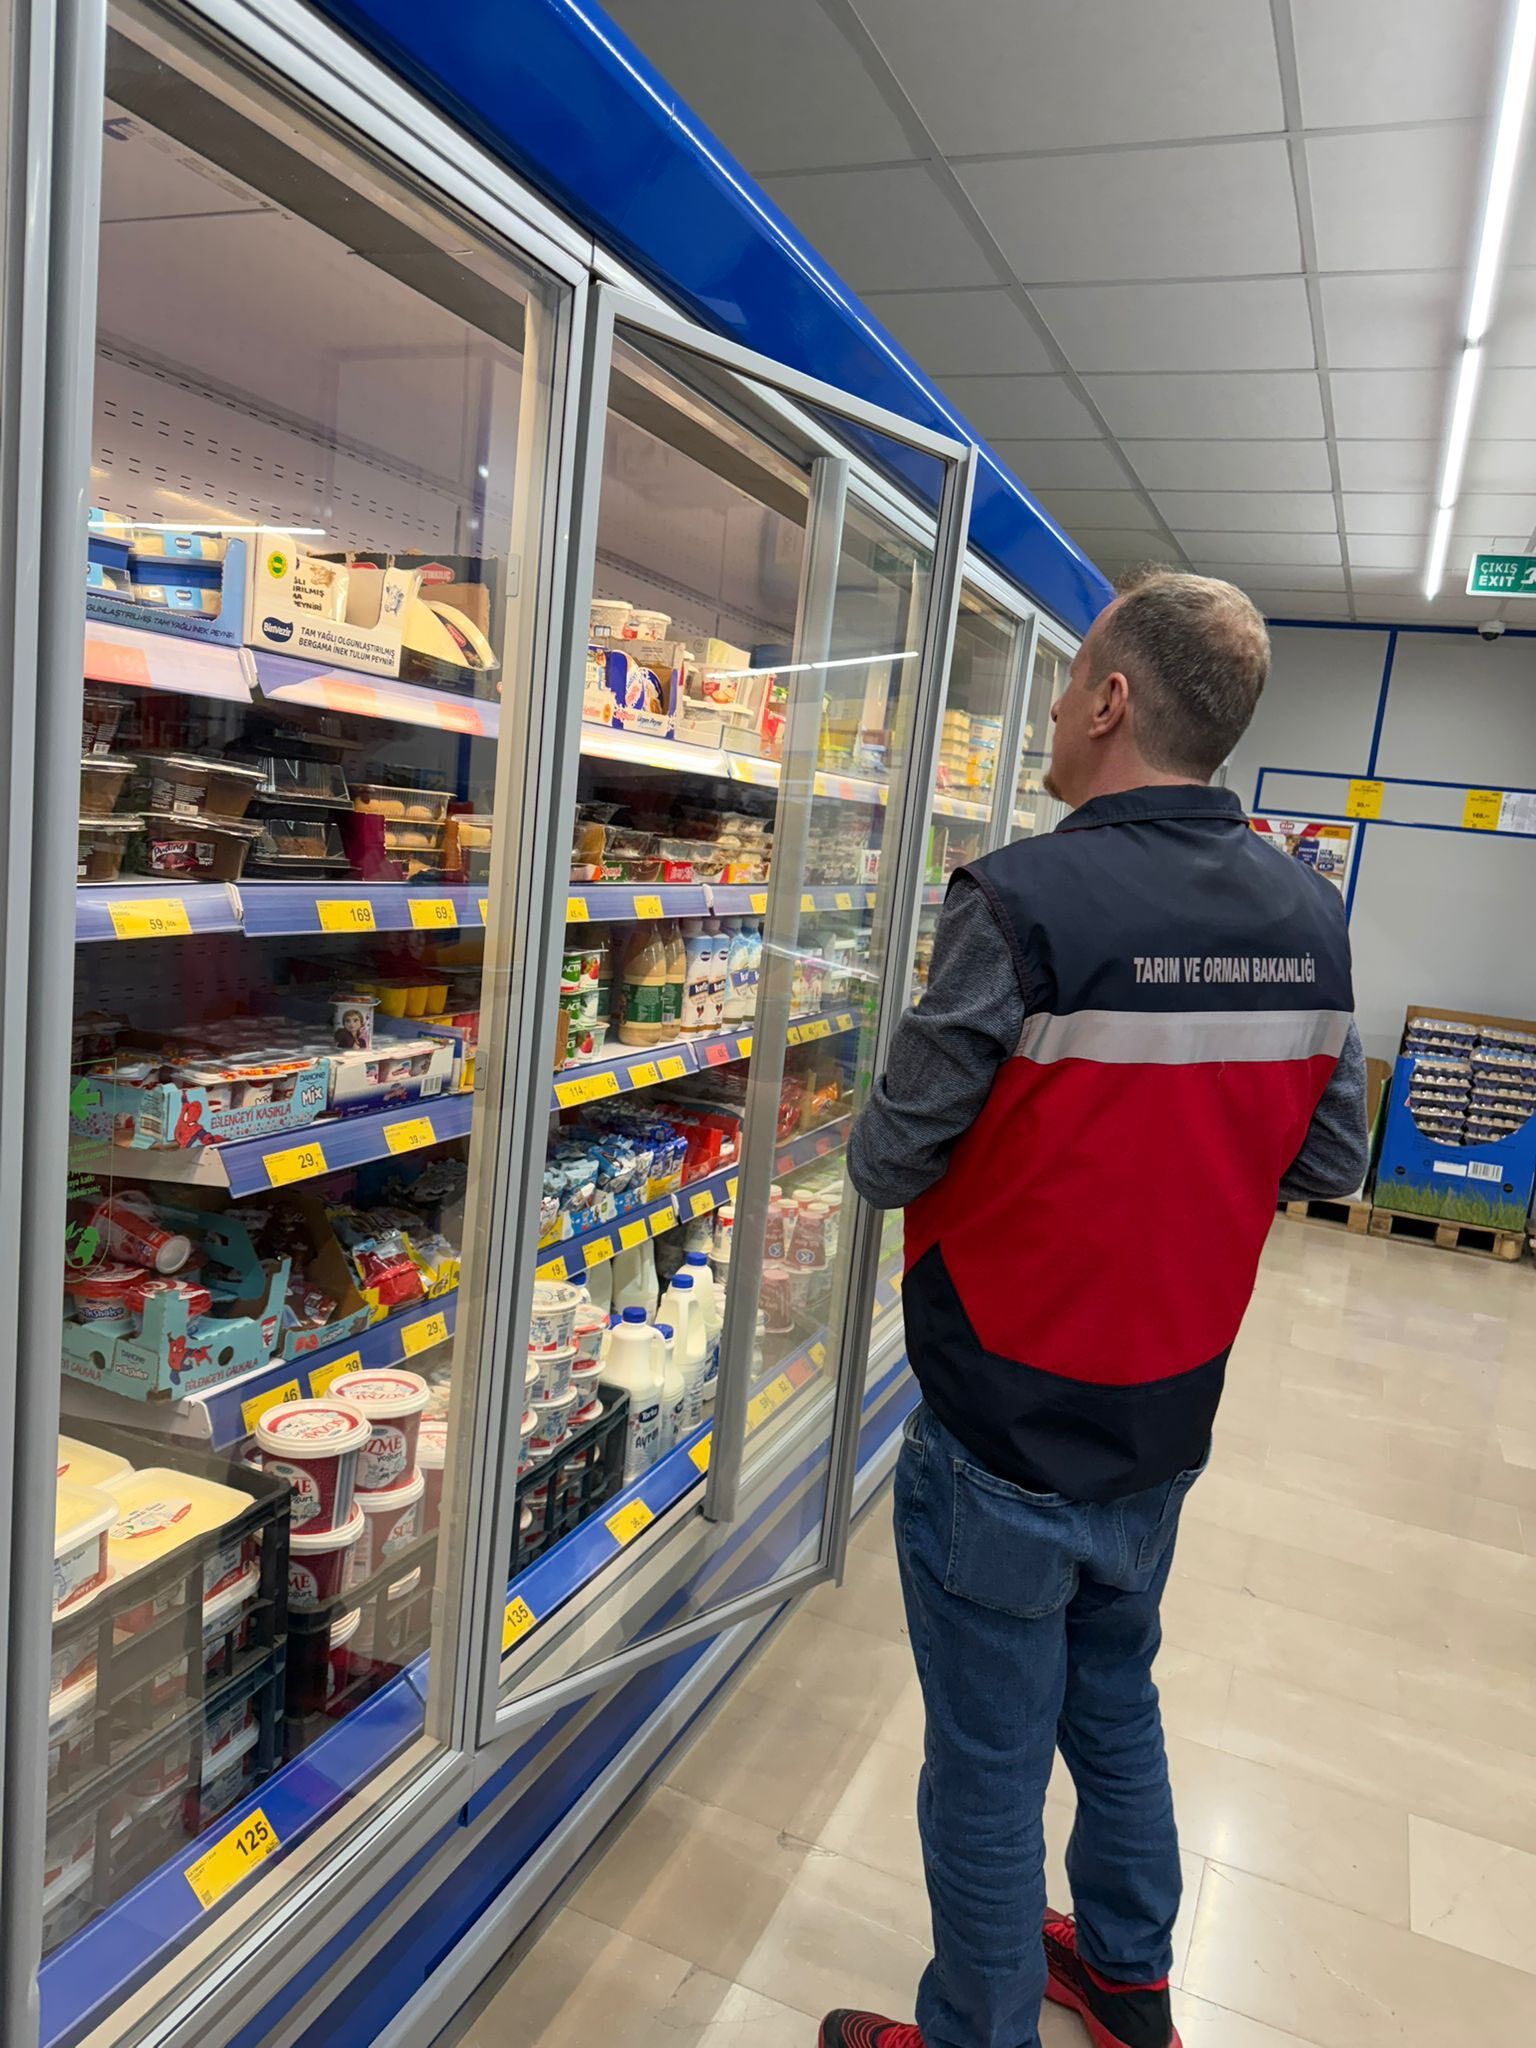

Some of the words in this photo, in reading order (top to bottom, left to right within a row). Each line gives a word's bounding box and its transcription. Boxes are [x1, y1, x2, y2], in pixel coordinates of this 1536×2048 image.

[1480, 562, 1518, 576] ÇIKIŞ
[1478, 575, 1515, 587] EXIT
[293, 586, 325, 598] IRILMIŞ
[301, 626, 317, 638] TAM
[317, 630, 337, 643] YAĞLI
[337, 636, 396, 658] OLGUNLAŞTIRILMIŞ
[298, 637, 333, 654] BERGAMA
[332, 645, 349, 656] İNEK
[349, 649, 372, 662] TULUM
[153, 843, 187, 857] Puding
[350, 908, 371, 922] 169
[562, 964, 580, 973] ACTI
[1133, 957, 1180, 983] TARIM
[1183, 957, 1201, 983] VE
[1203, 957, 1250, 983] ORMAN
[1252, 952, 1316, 983] BAKANLIĞI
[299, 1071, 326, 1082] DANONE
[210, 1110, 253, 1130] EĞLENCEYİ
[255, 1103, 292, 1120] KAŞIKLA
[282, 1387, 299, 1403] 46
[288, 1589, 313, 1600] oğurt
[507, 1604, 529, 1628] 135
[235, 1820, 269, 1857] 125
